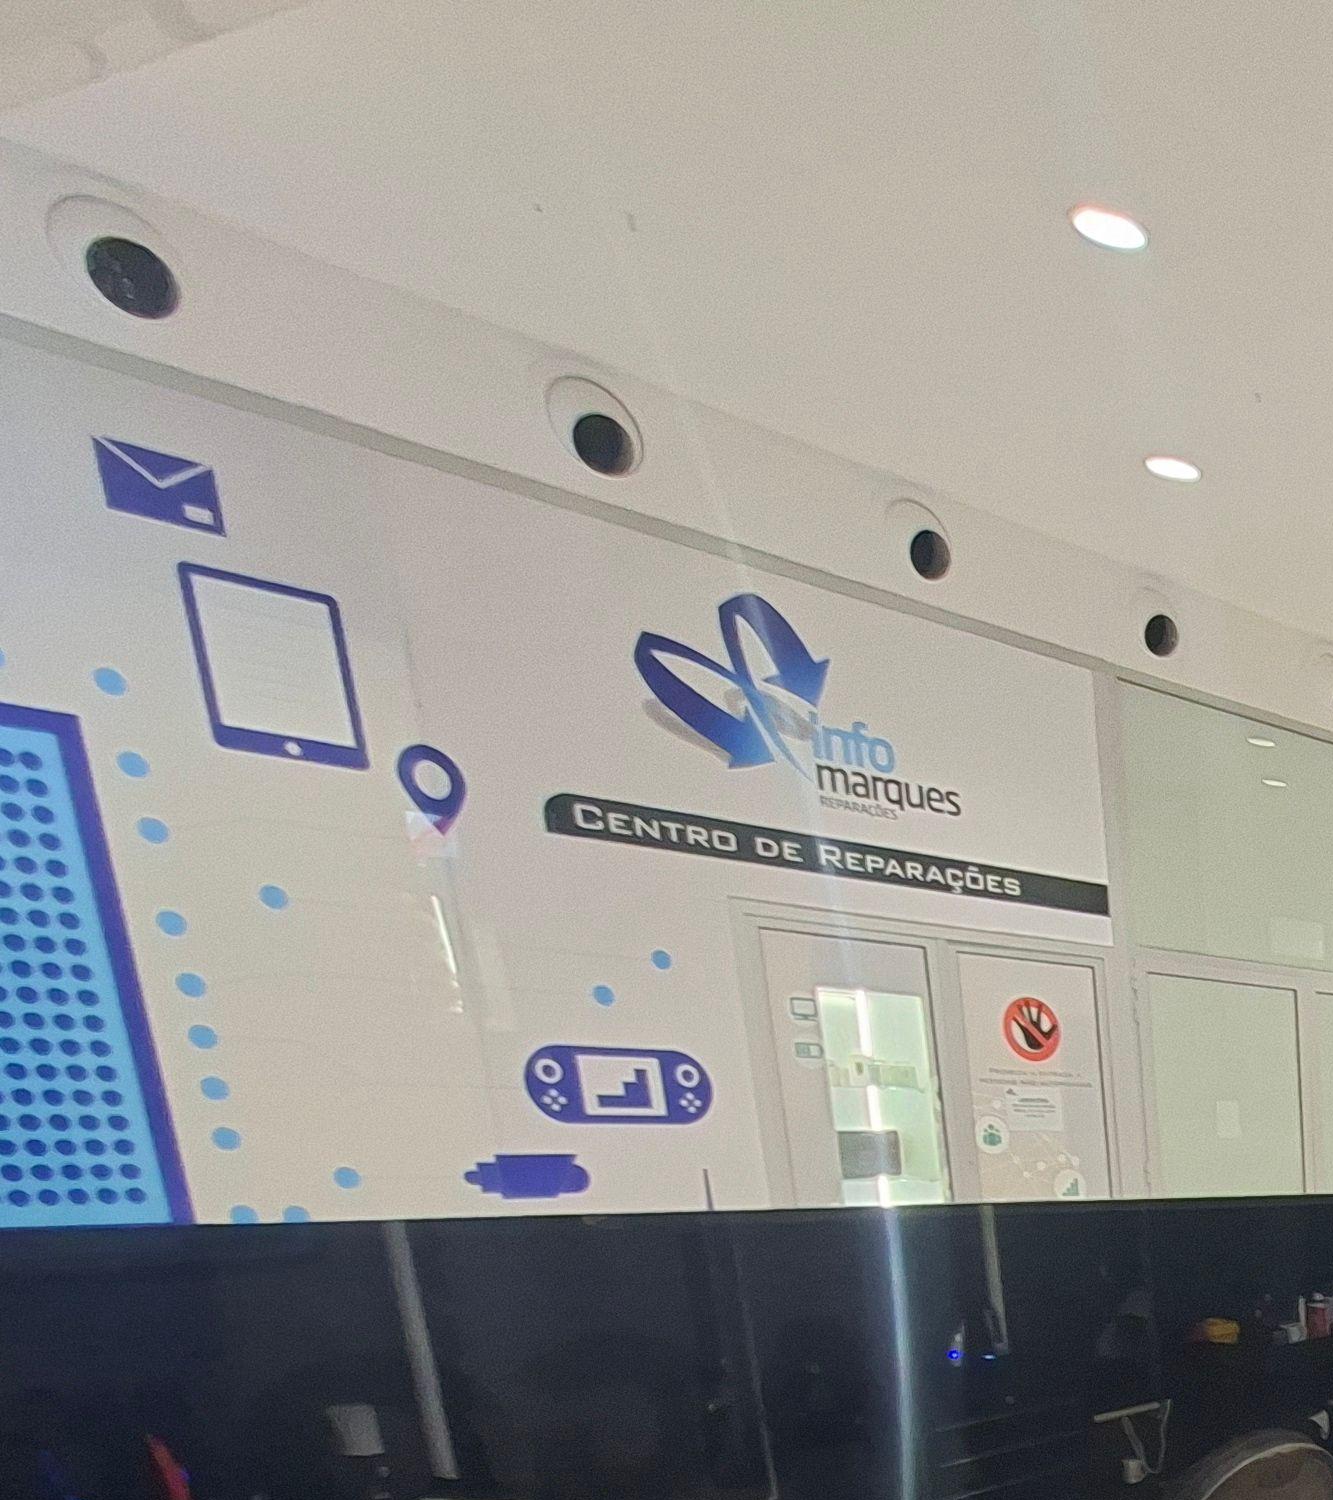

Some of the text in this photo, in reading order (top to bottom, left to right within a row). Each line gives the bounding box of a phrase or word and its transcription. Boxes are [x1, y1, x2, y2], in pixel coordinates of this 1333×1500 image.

[808, 711, 895, 773] info
[816, 763, 961, 816] marques
[573, 803, 738, 853] CENTRO
